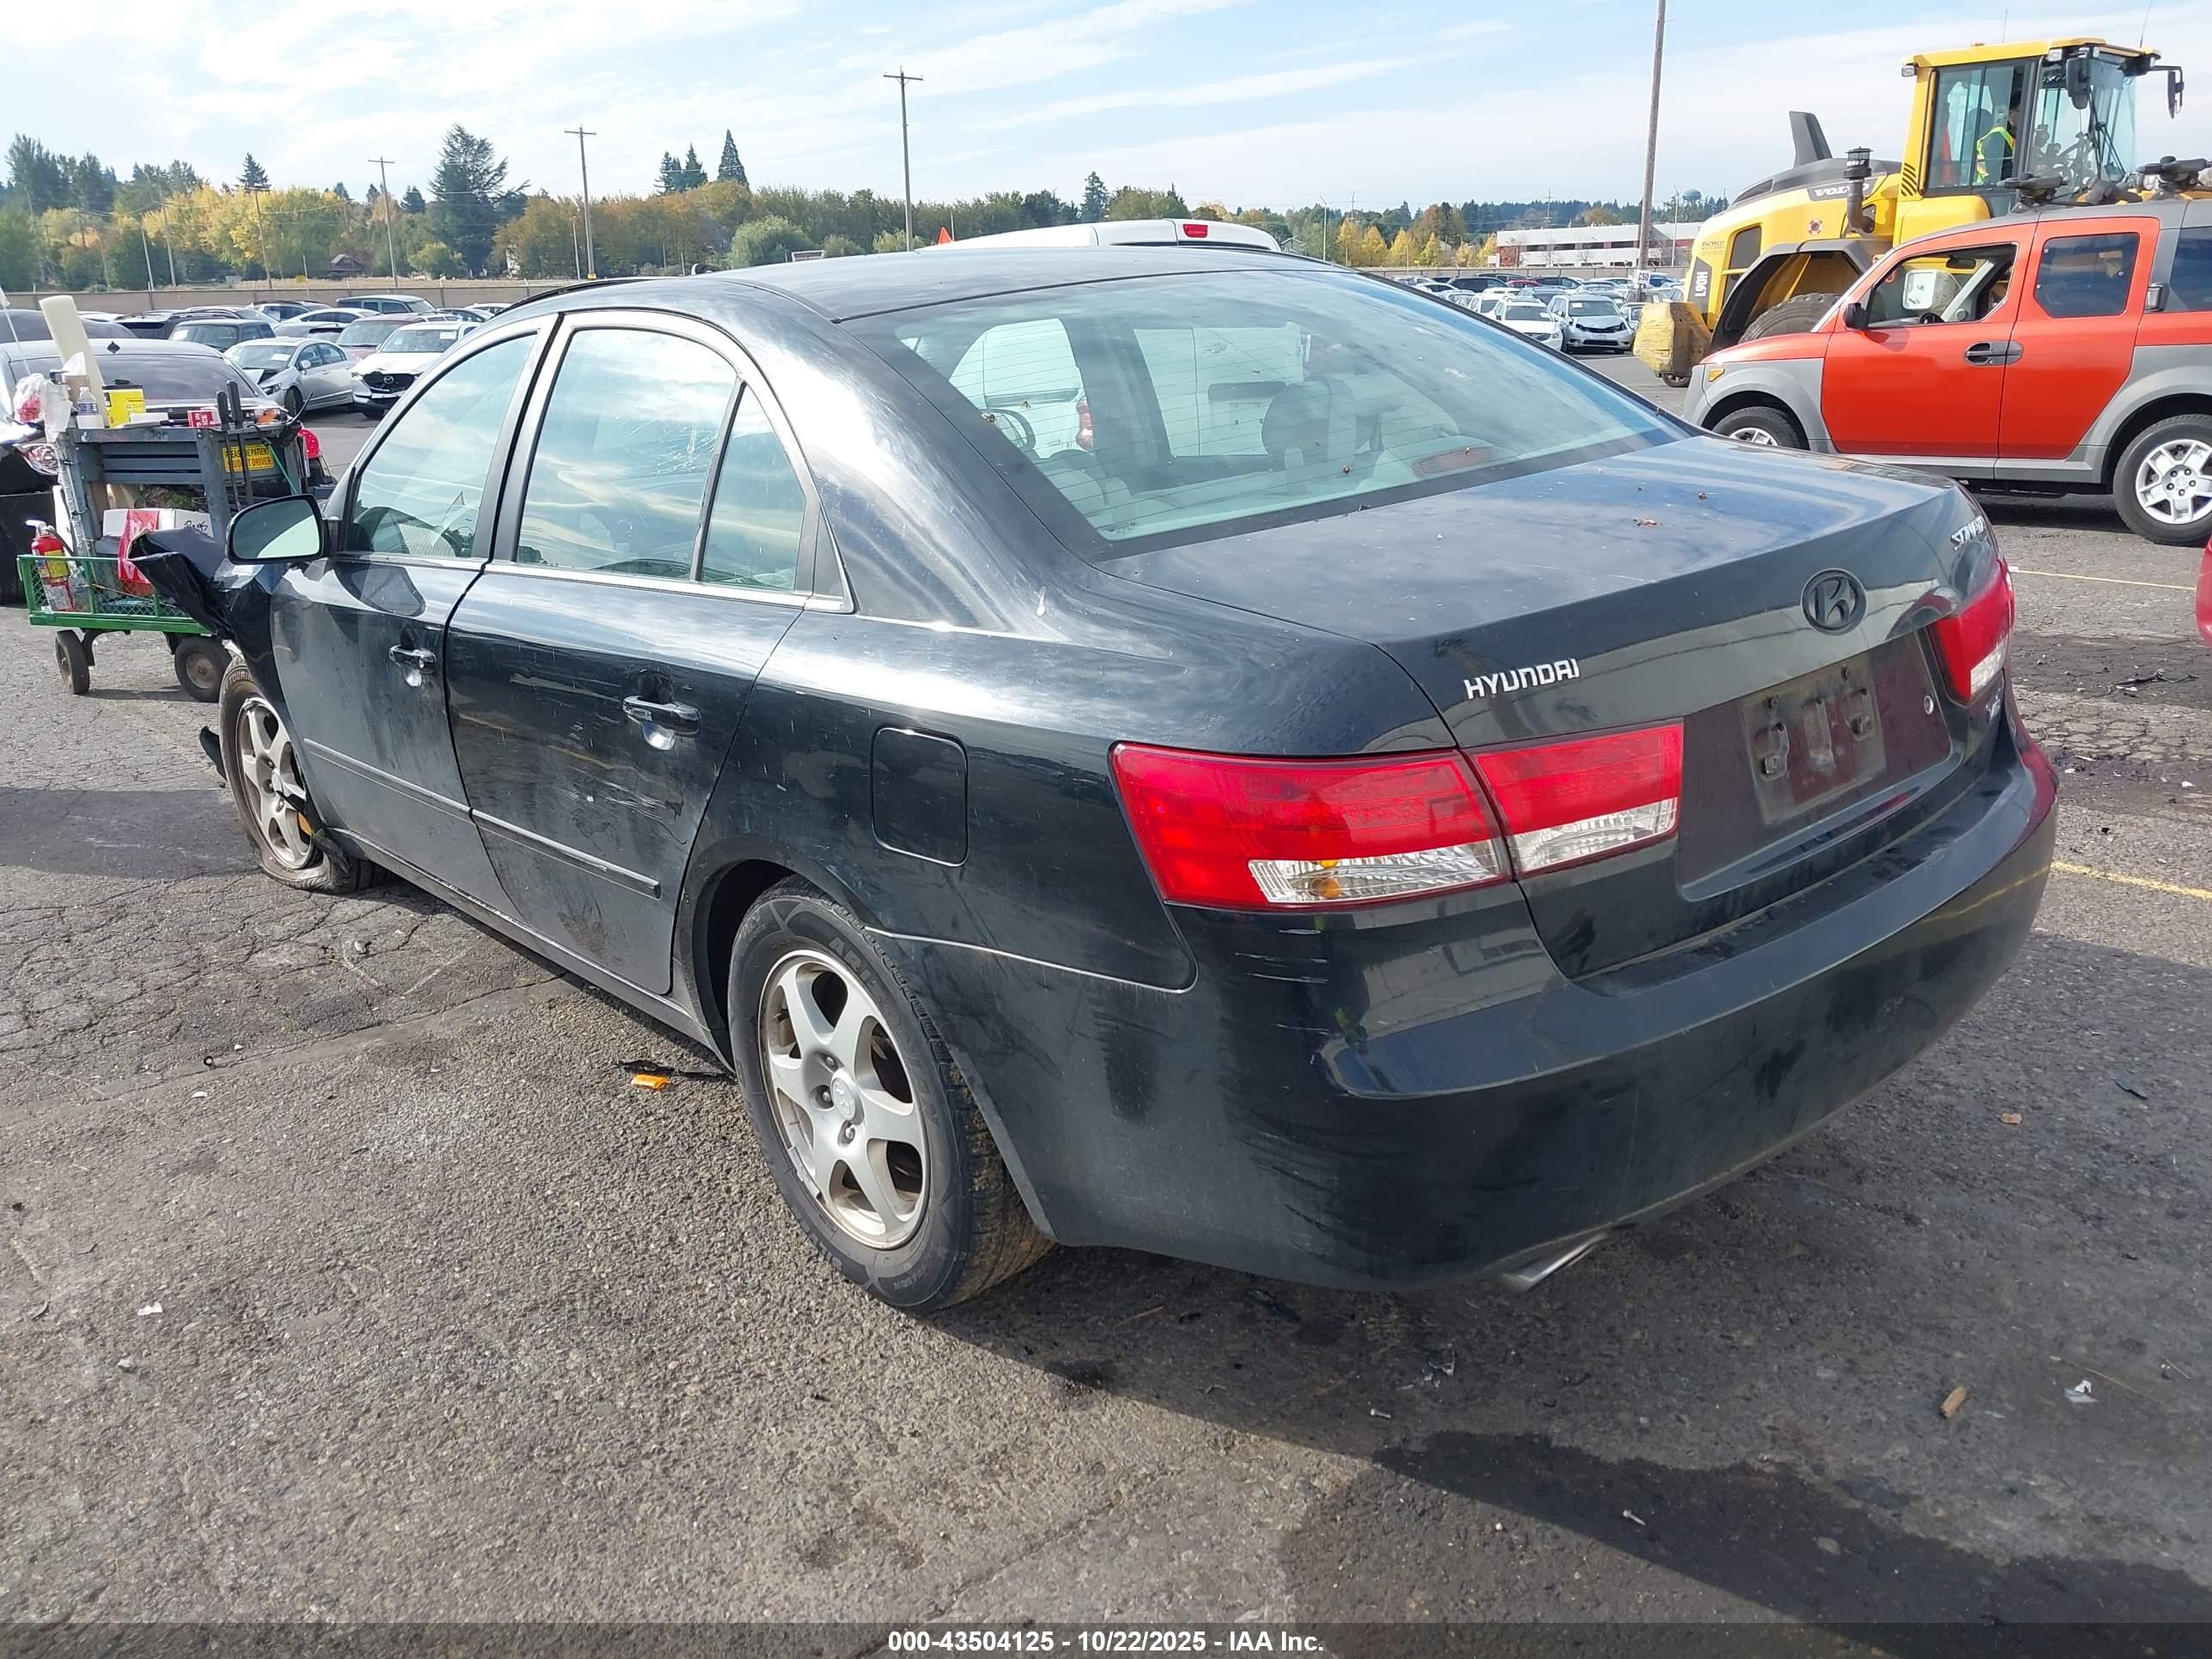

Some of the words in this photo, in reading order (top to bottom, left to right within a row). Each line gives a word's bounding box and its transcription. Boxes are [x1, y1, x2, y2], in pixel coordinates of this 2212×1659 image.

[1814, 183, 1870, 197] VOLO
[1638, 272, 1650, 282] C50
[1463, 658, 1580, 699] HYUNDAI
